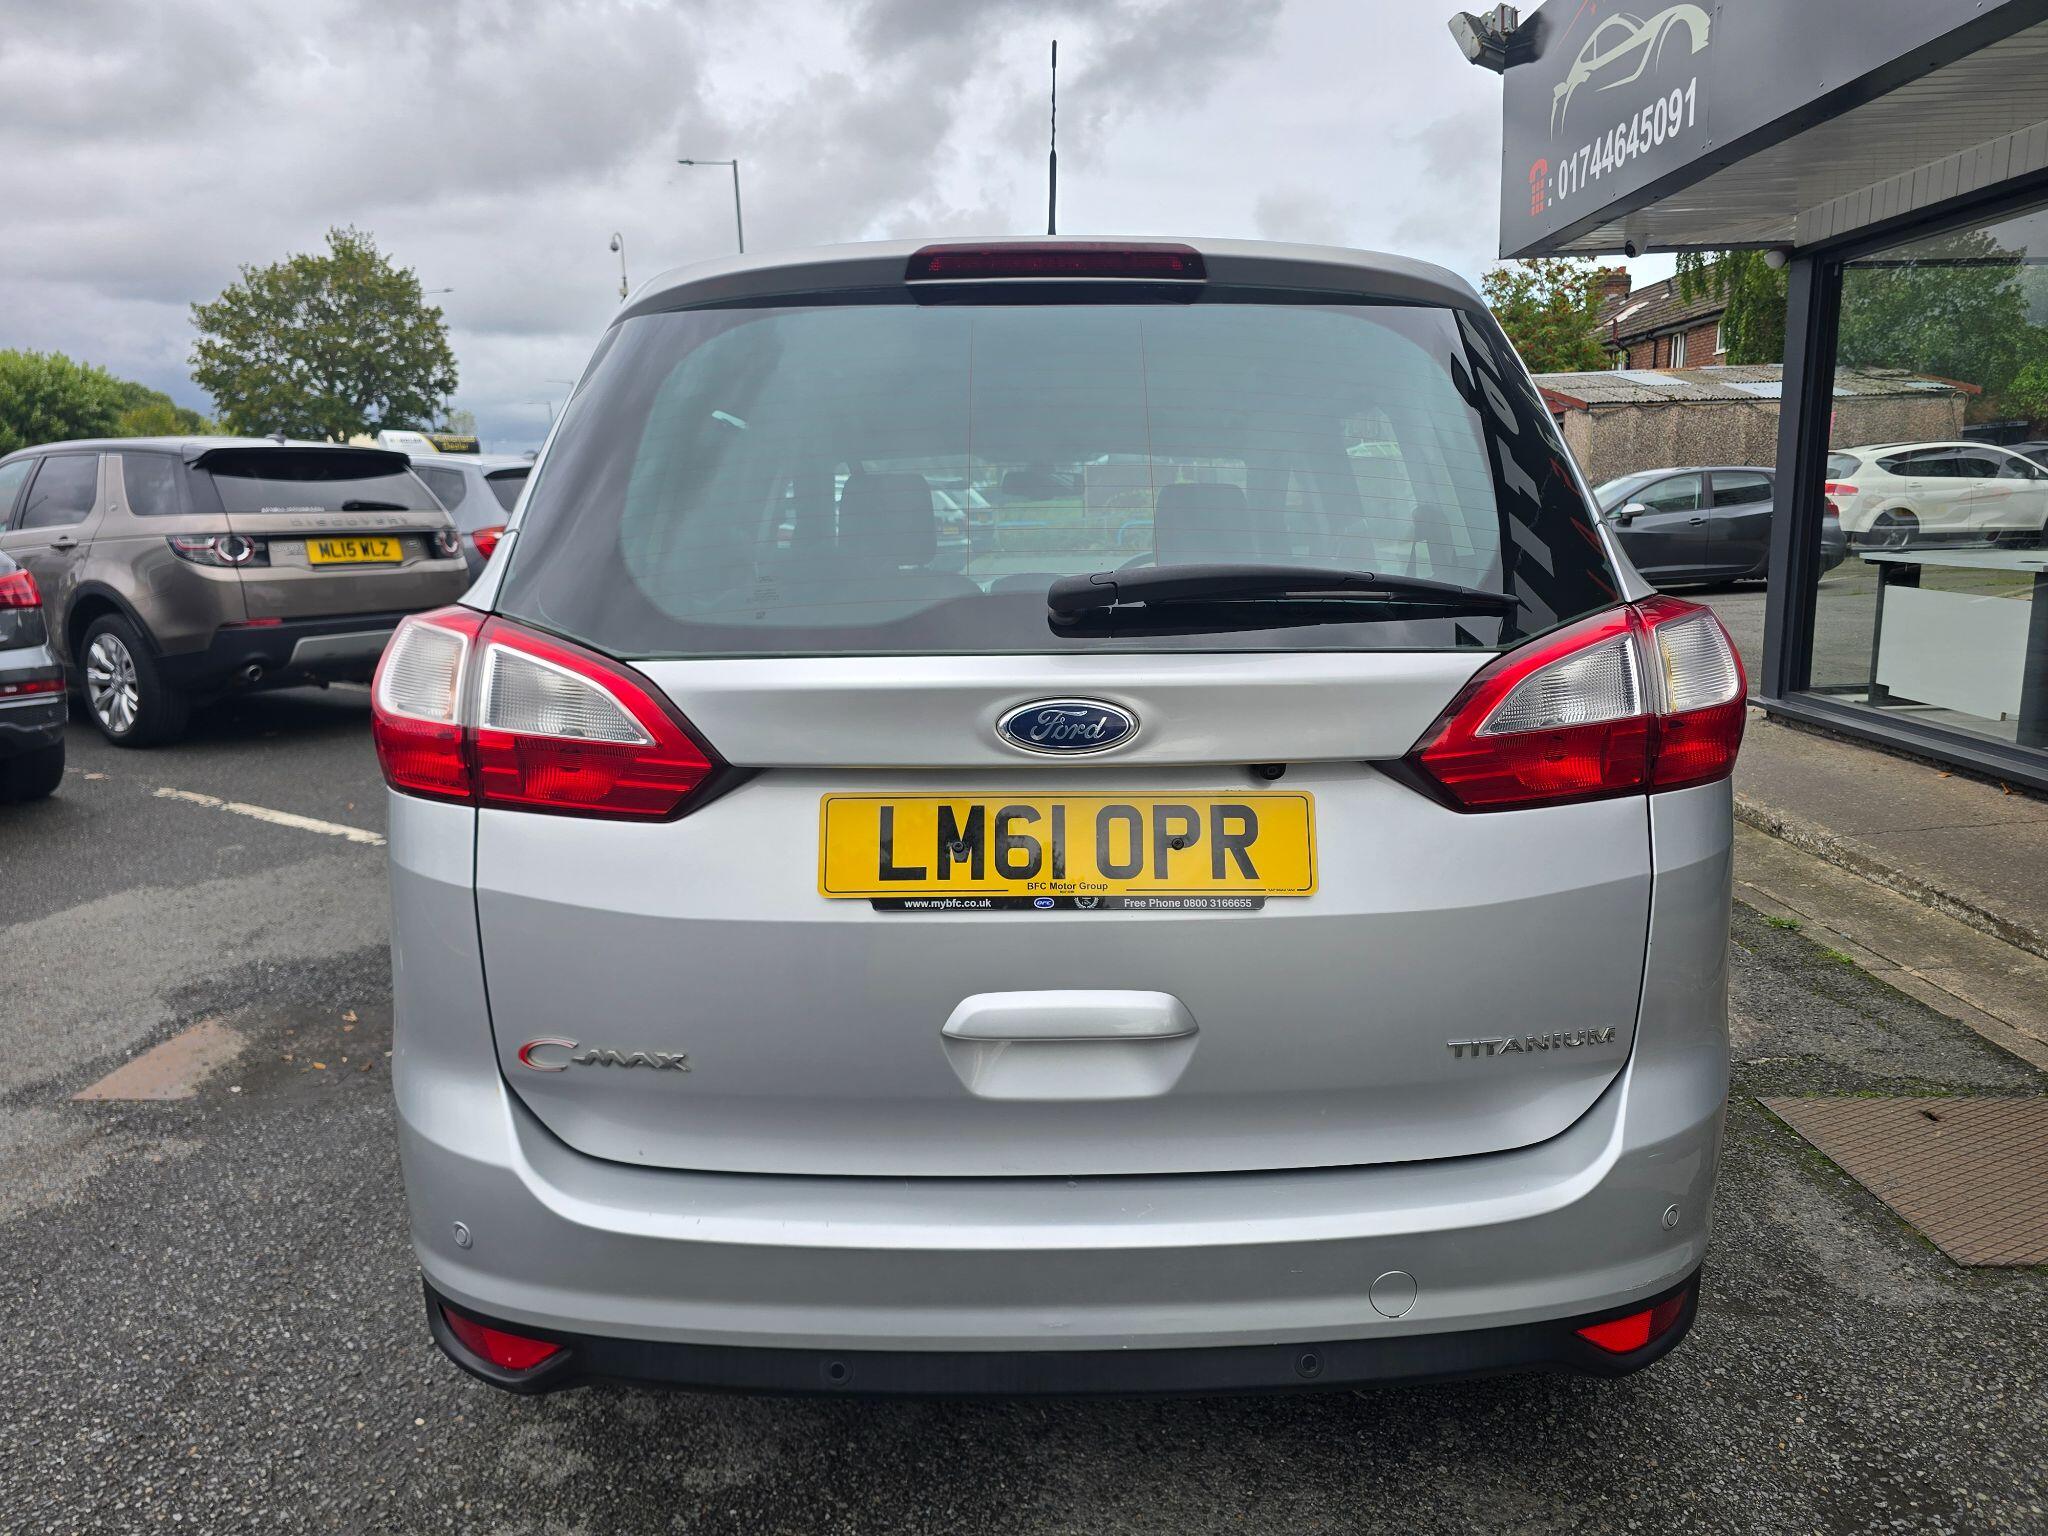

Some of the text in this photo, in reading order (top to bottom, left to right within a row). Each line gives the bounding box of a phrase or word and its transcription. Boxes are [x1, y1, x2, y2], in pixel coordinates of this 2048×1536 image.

[1558, 76, 1697, 200] 01744645091
[319, 542, 357, 558] ML15
[360, 541, 390, 557] WLZ
[1029, 709, 1108, 741] Ford
[878, 803, 1261, 881] LM61 OPR
[1027, 882, 1109, 892] BFC Motor Group
[904, 898, 992, 910] www.mybfc.co.uk
[1124, 898, 1147, 908] Free
[1150, 898, 1181, 908] Phone
[1183, 898, 1208, 908] 0800
[1210, 898, 1252, 908] 3166655
[1447, 1027, 1617, 1058] TITANIUM
